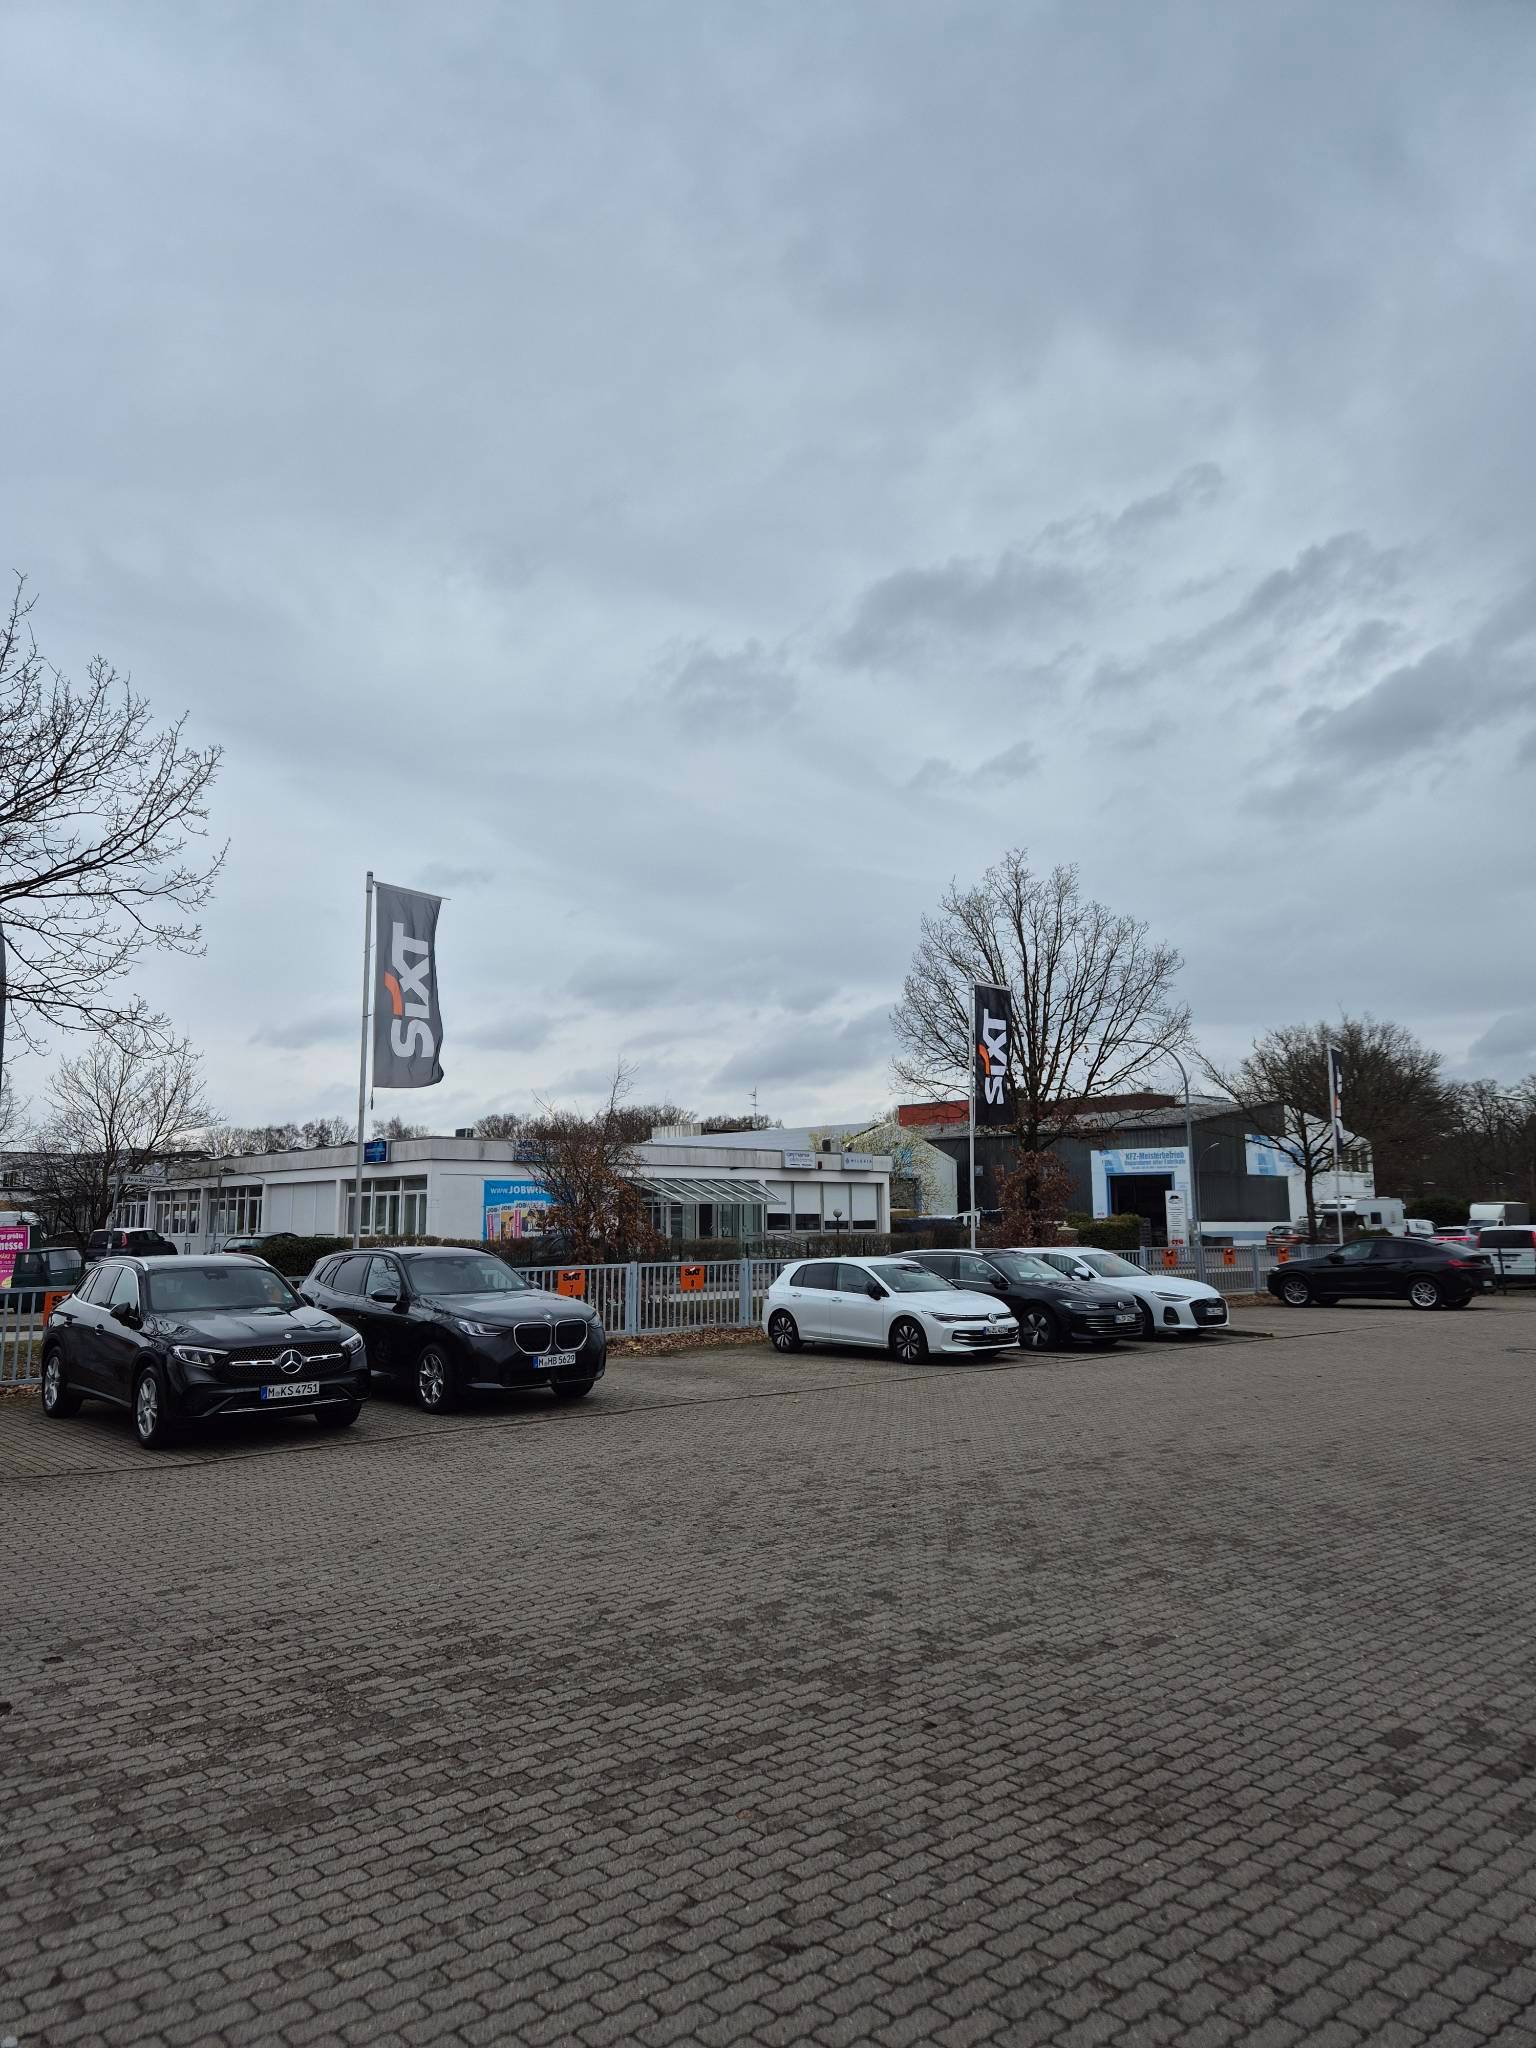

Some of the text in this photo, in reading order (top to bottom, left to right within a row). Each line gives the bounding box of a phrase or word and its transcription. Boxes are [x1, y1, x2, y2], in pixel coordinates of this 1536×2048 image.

[384, 921, 435, 1058] SIXT
[978, 1008, 1008, 1105] SIXT
[562, 1272, 582, 1281] SIXT
[295, 1383, 319, 1394] 4751
